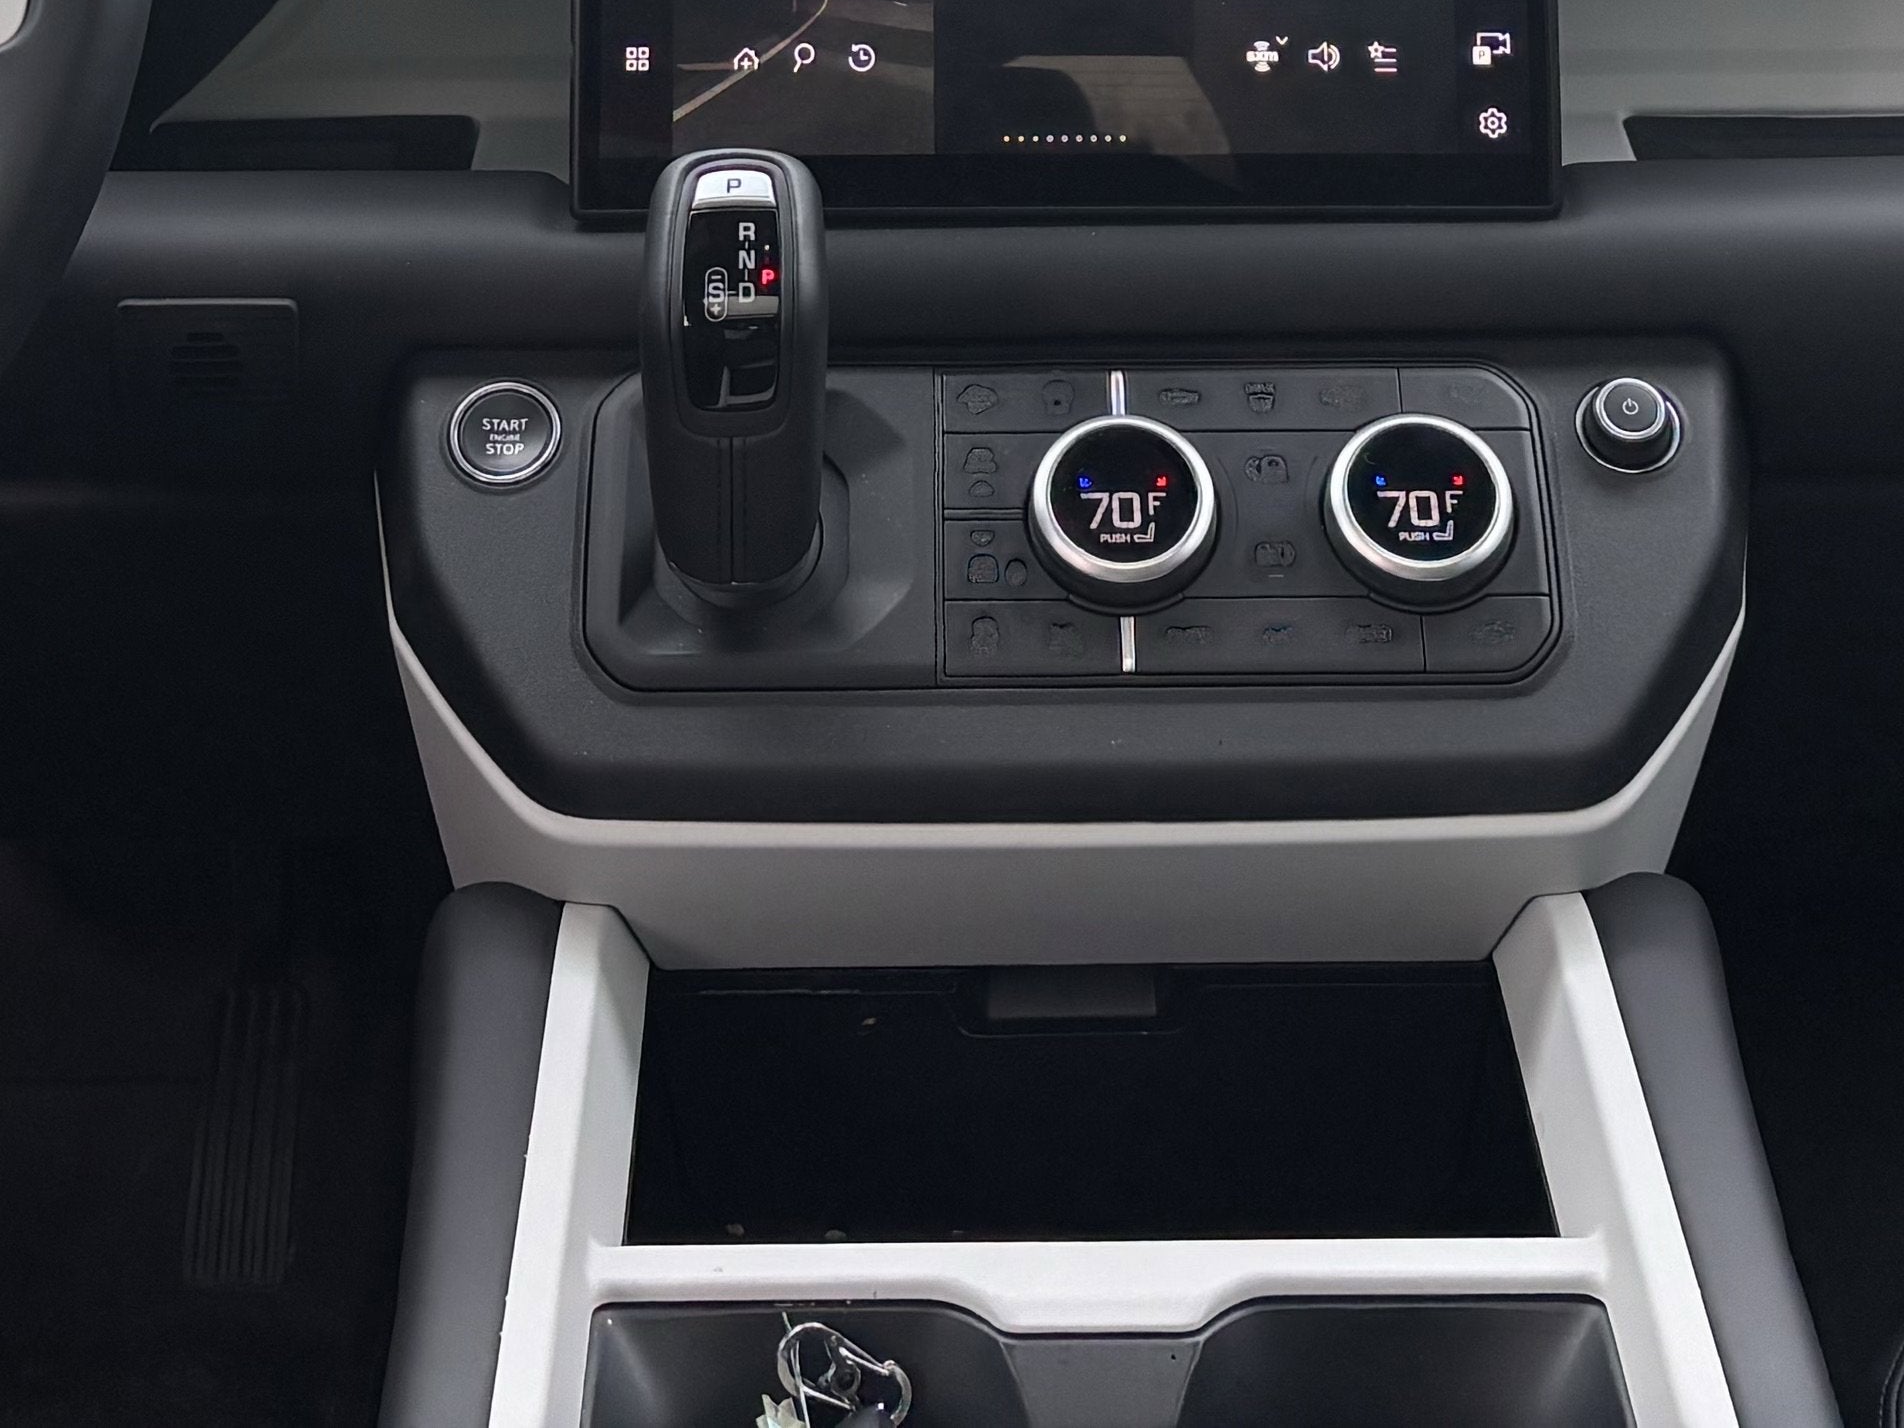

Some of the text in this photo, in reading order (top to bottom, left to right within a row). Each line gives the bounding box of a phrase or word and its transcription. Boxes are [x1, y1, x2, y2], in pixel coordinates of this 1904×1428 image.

[726, 178, 742, 194] P
[738, 221, 756, 241] R
[738, 249, 756, 270] N
[761, 269, 775, 285] P
[708, 282, 725, 303] S
[738, 282, 756, 303] D
[482, 417, 529, 431] START
[485, 443, 525, 456] STOP
[1099, 533, 1131, 544] PUSH
[1398, 531, 1430, 542] PUSH
